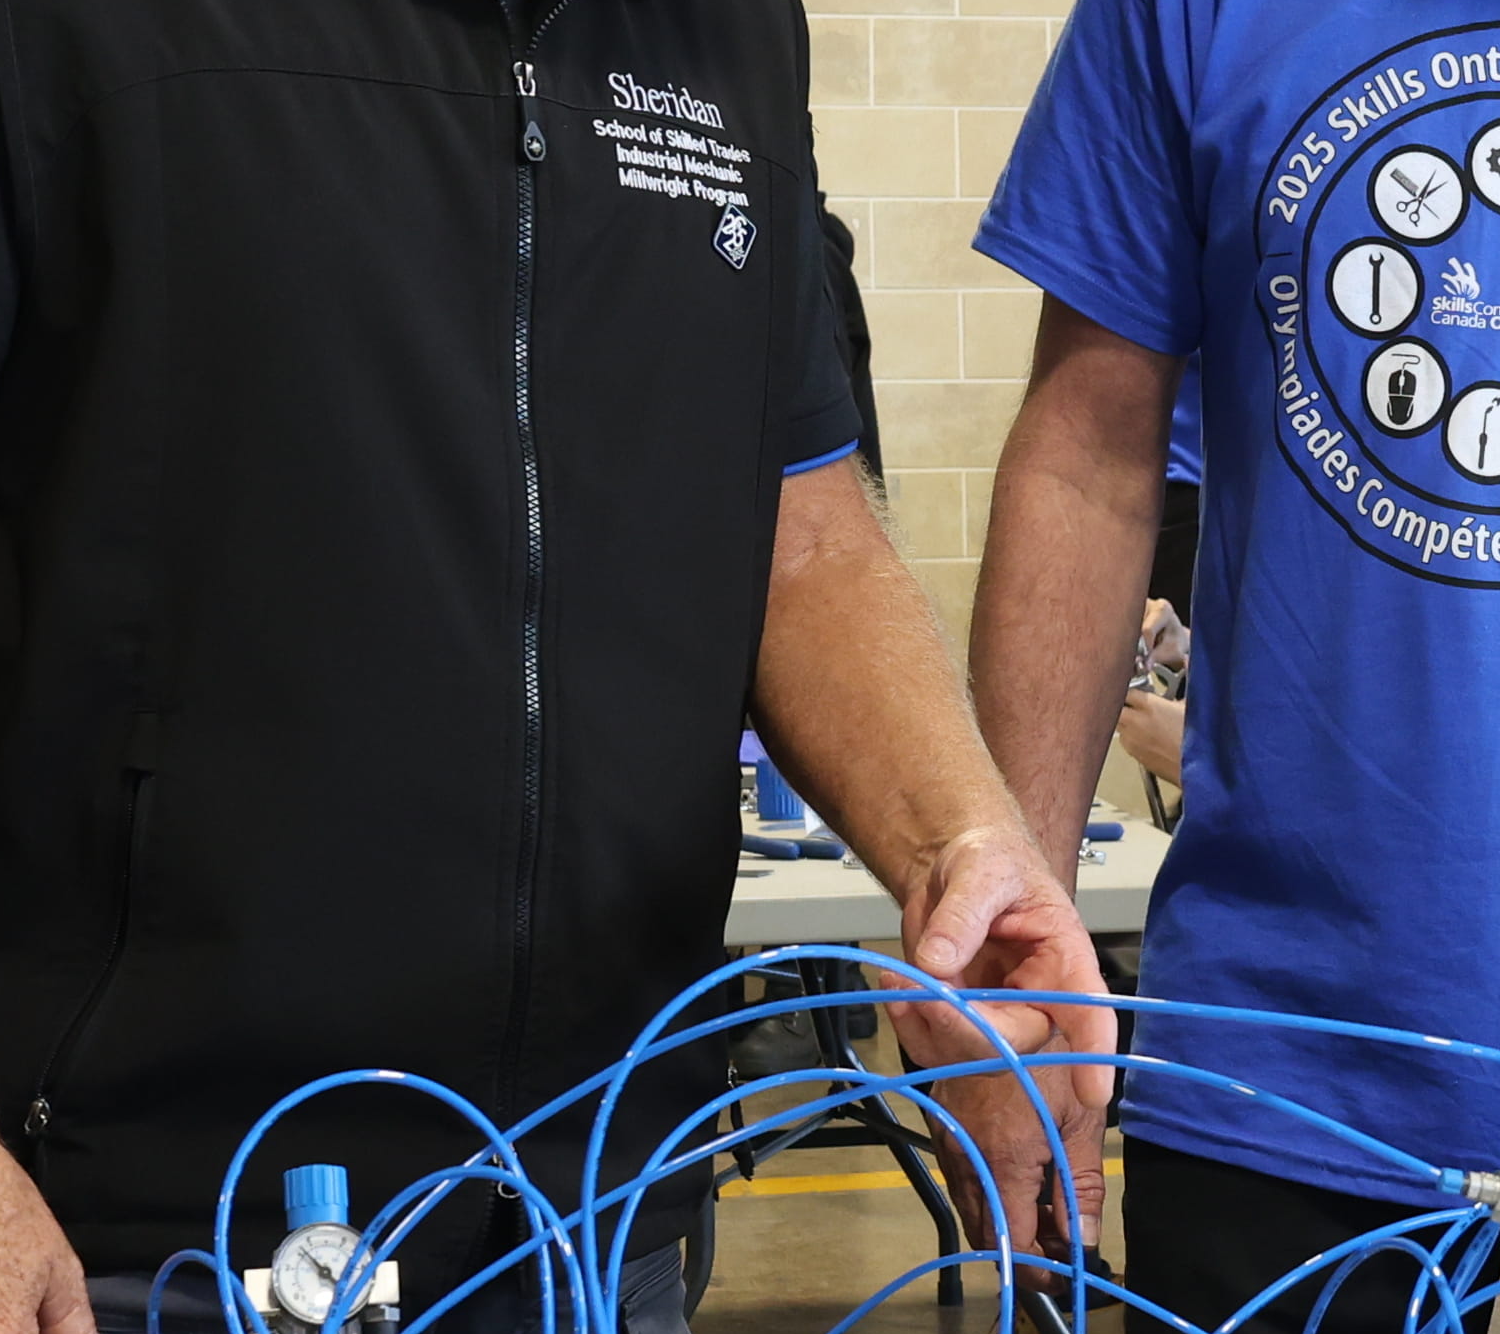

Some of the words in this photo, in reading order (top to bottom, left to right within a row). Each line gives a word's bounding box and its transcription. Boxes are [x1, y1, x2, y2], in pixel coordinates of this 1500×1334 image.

[607, 71, 725, 131] Sheridan
[592, 118, 648, 143] School
[649, 127, 664, 146] of
[665, 129, 709, 156] Skilled
[707, 137, 752, 164] Trades
[615, 142, 683, 172] Industrial
[684, 154, 744, 184] Mechanic
[1268, 130, 1337, 224] 2025
[1326, 66, 1427, 143] Skills
[618, 167, 692, 199] Millwright
[693, 180, 750, 207] Program
[1430, 310, 1487, 330] Canada
[1268, 273, 1360, 494] Olympiades
